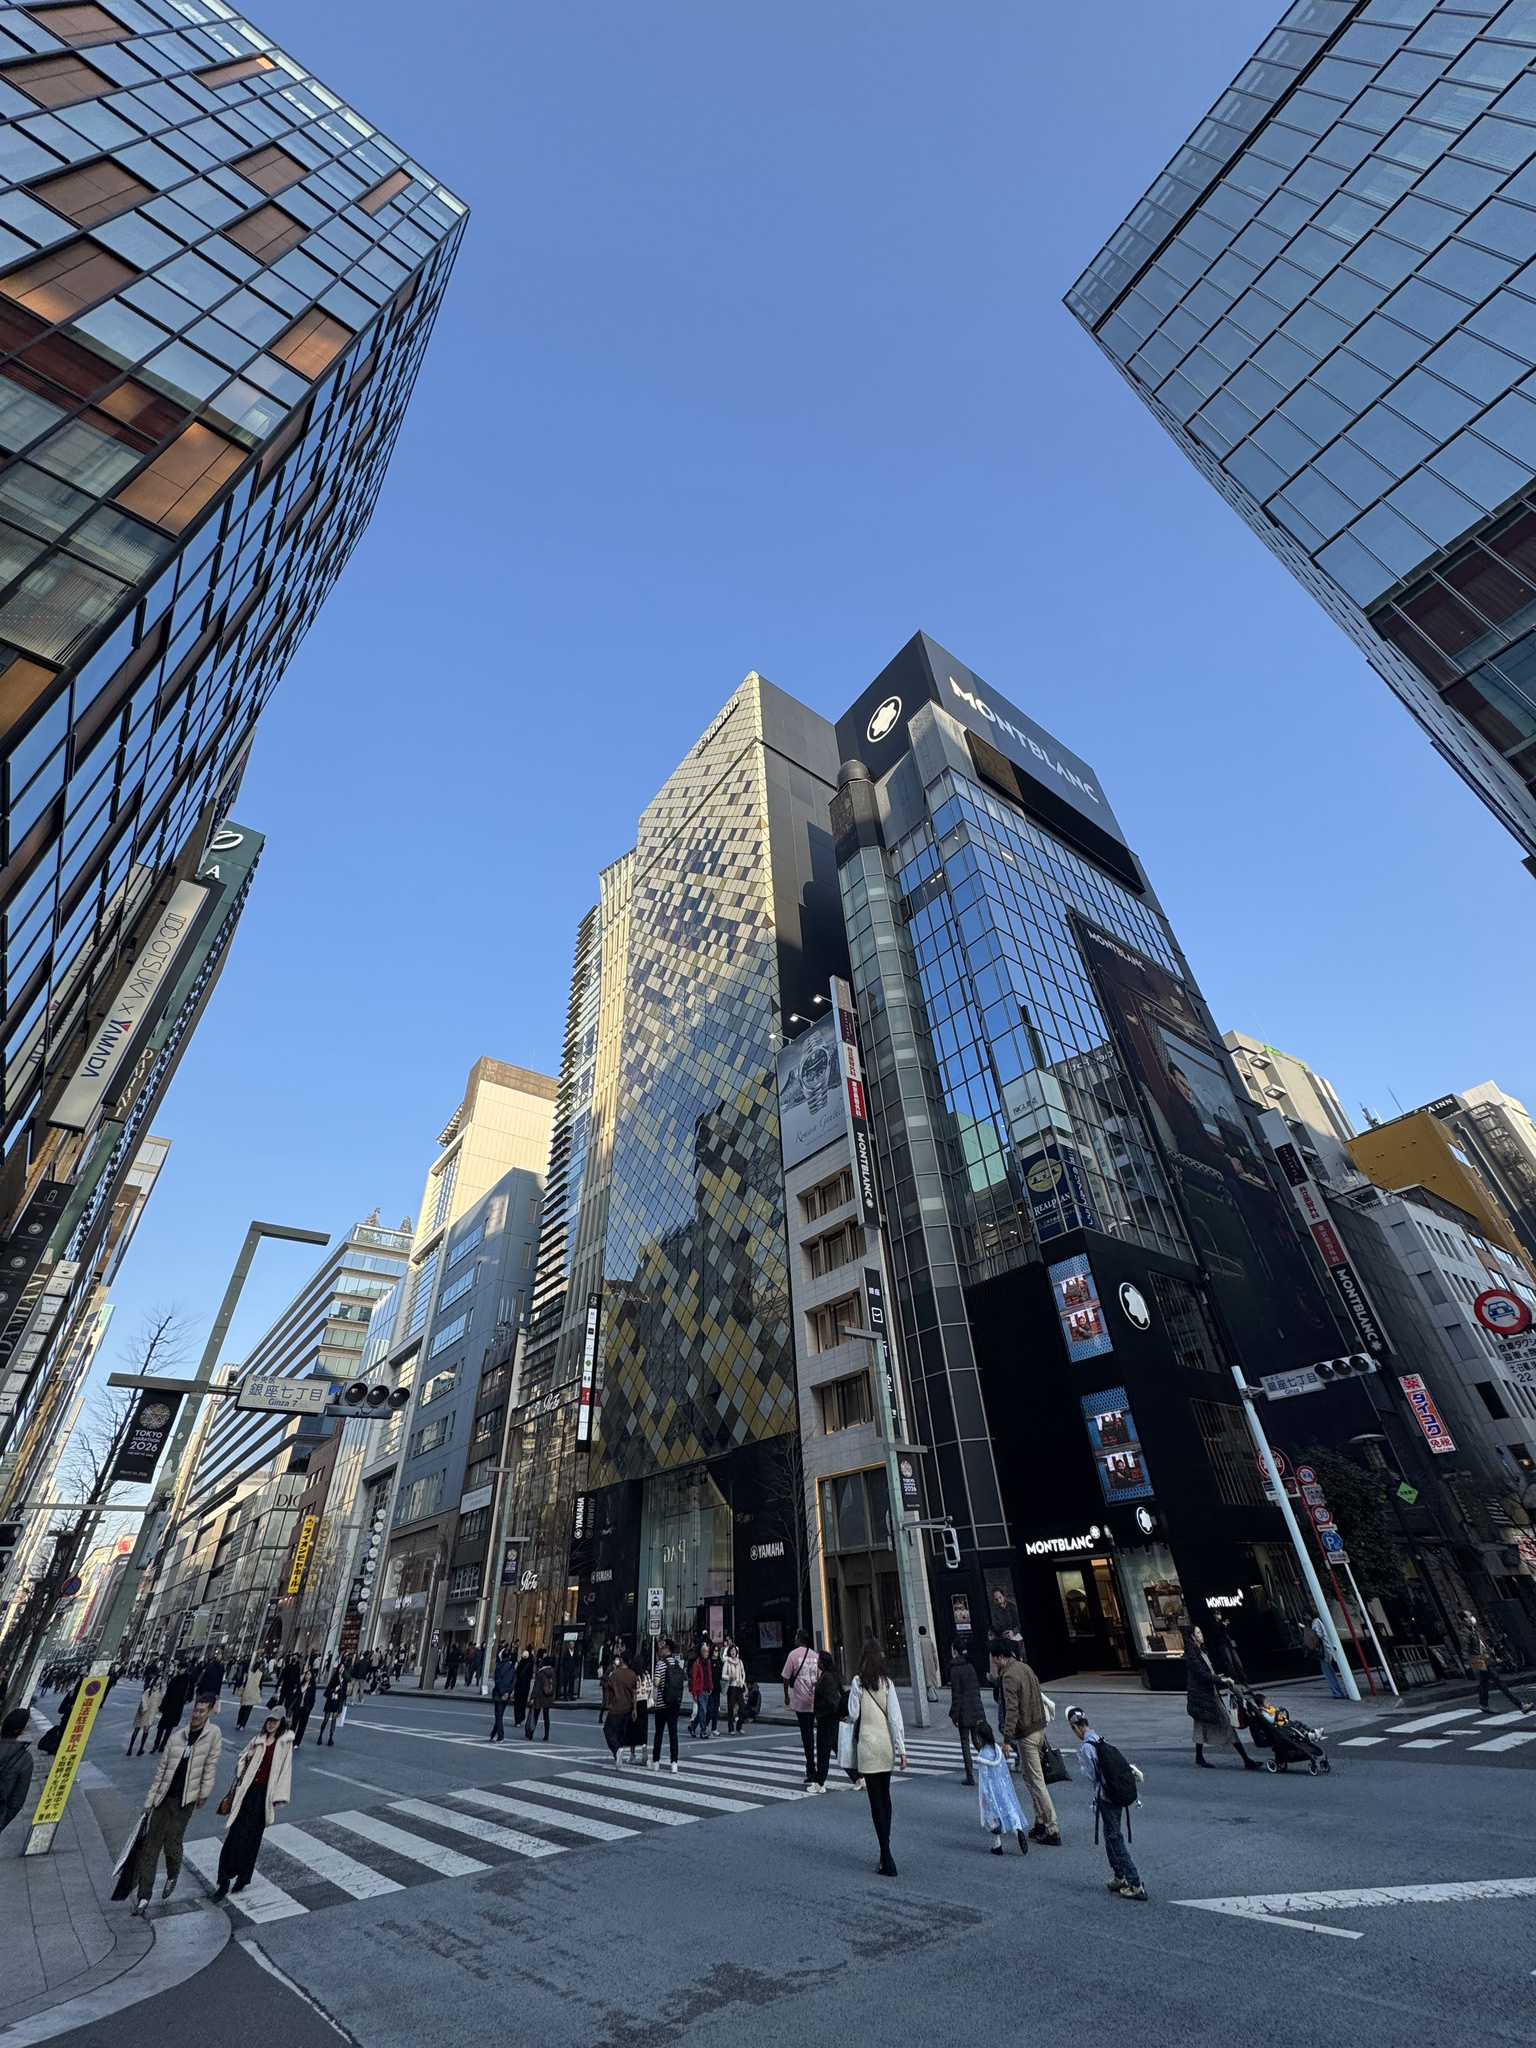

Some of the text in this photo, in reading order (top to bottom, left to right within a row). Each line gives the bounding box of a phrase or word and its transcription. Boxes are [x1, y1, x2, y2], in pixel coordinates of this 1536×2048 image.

[705, 696, 740, 743] YAMAHA
[949, 676, 1100, 804] MONTBLANC
[1086, 928, 1146, 972] MONTBLANC
[123, 940, 171, 999] OTSUKA
[80, 1019, 133, 1078] YAMADA
[114, 1048, 154, 1118] DAMIANI
[1435, 1098, 1453, 1111] INN
[857, 1131, 873, 1202] MONTBLANC
[1336, 1268, 1379, 1342] MONTBLANC
[248, 1383, 323, 1402] 銀座七丁目
[252, 1375, 276, 1384] 中央区
[1267, 1372, 1318, 1392] 銀座七丁目
[268, 1398, 298, 1407] Ginza 7
[1412, 1392, 1442, 1437] ダイコク
[128, 1440, 158, 1452] 2026
[135, 1429, 163, 1439] TOKYO
[1430, 1437, 1452, 1450] 免税
[575, 1497, 585, 1529] YAMAHA
[1317, 1510, 1329, 1519] 30
[290, 1528, 312, 1587] ライオンビヤホール
[757, 1541, 785, 1559] YAMAHA
[1025, 1534, 1094, 1556] MONTBLANC
[1205, 1595, 1243, 1609] MONTBLANC
[65, 1697, 94, 1753] 違法駐車禁止
